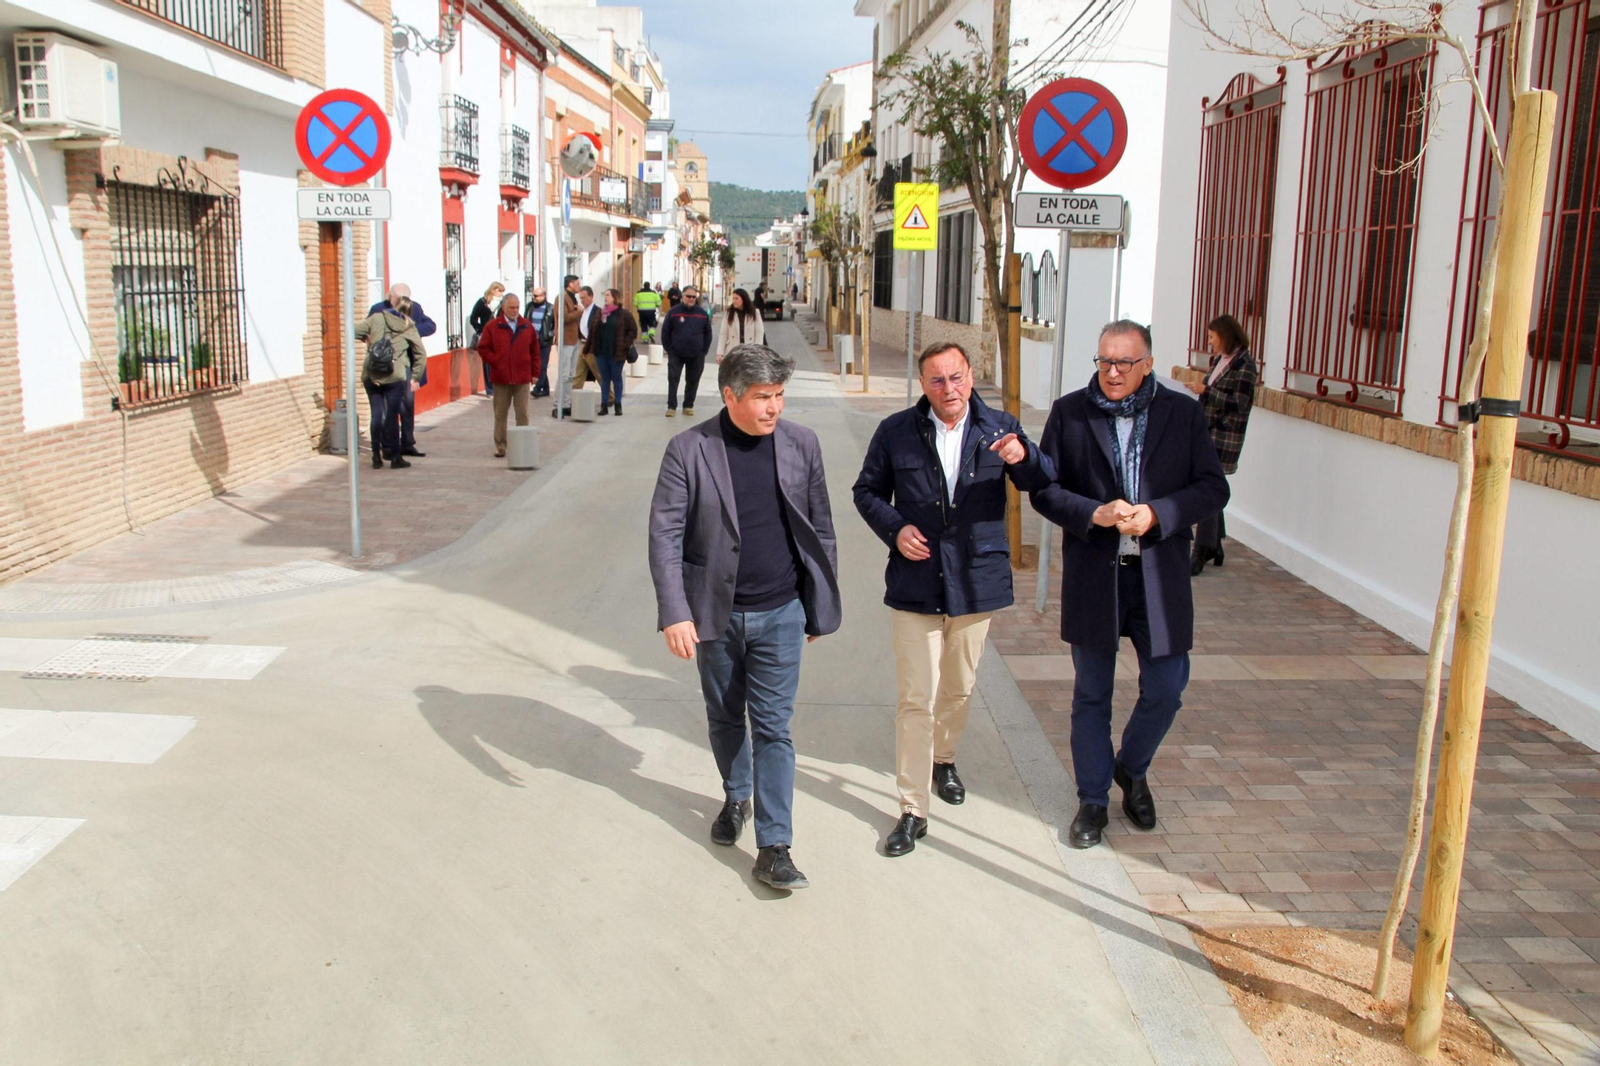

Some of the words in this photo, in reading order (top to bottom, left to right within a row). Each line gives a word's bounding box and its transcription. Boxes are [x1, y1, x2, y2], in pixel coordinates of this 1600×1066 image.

[317, 192, 334, 203] EN
[337, 192, 370, 203] TODA
[1039, 197, 1058, 209] EN
[1061, 198, 1098, 210] TODA
[316, 206, 331, 216] LA
[334, 206, 372, 216] CALLE
[1036, 213, 1053, 224] LA
[1056, 213, 1101, 225] CALLE
